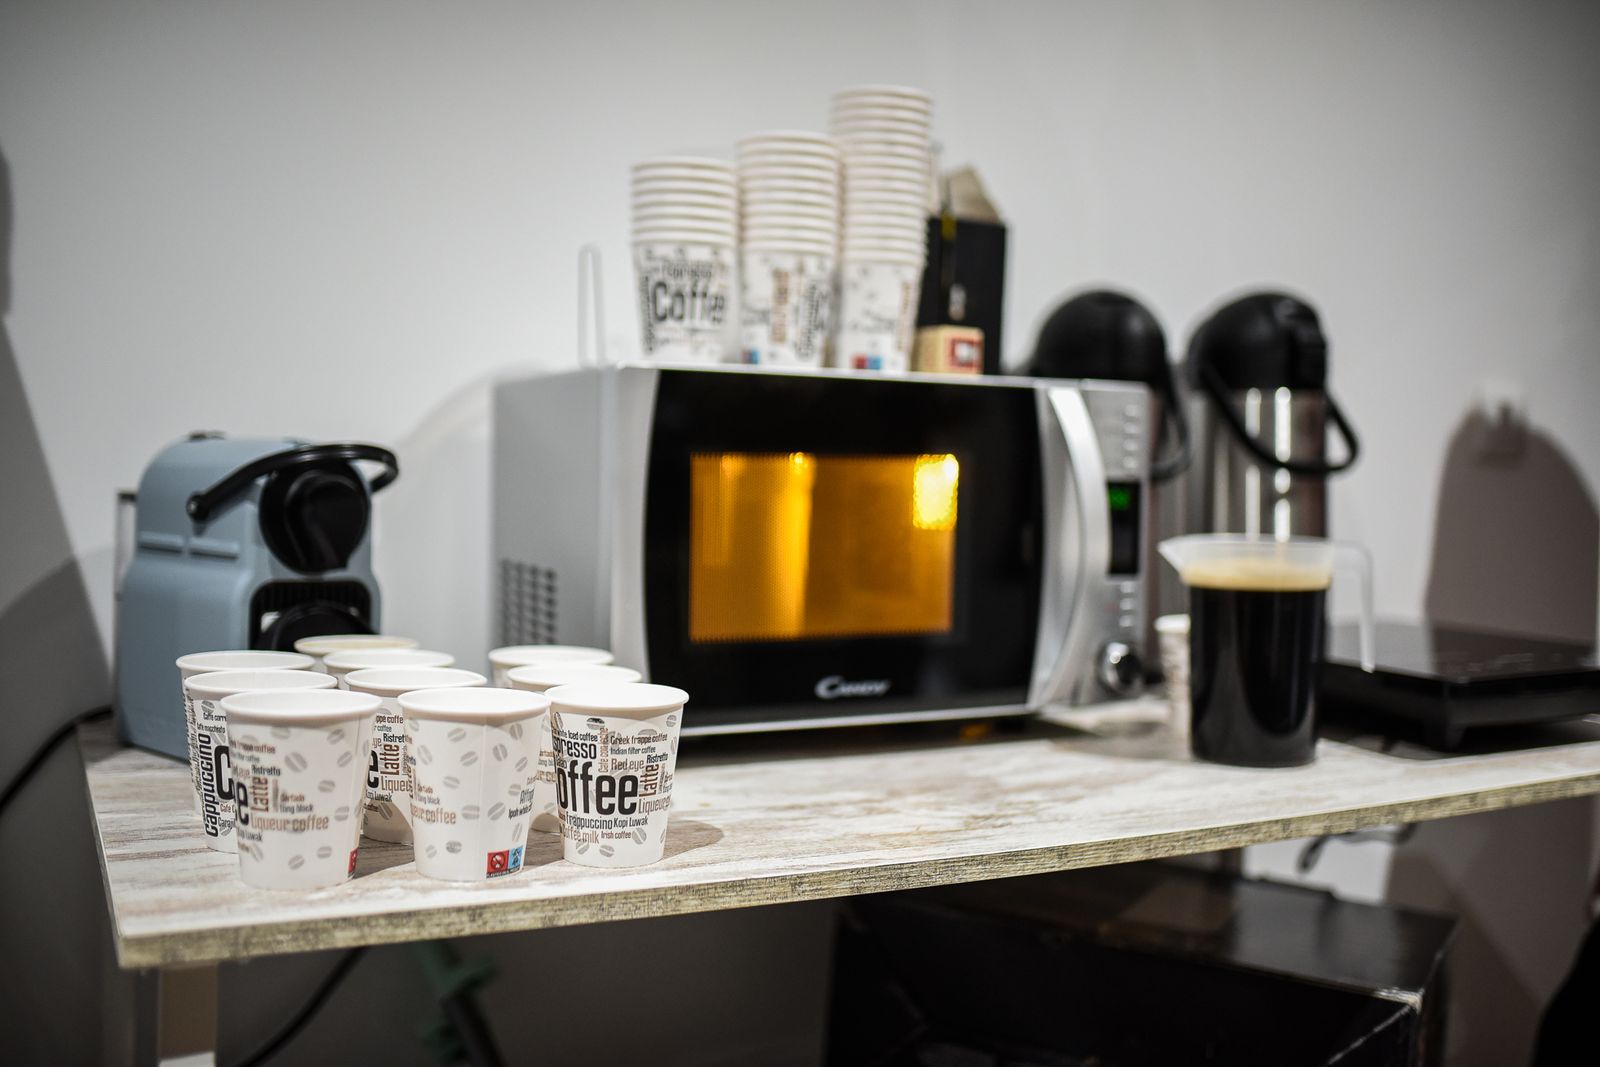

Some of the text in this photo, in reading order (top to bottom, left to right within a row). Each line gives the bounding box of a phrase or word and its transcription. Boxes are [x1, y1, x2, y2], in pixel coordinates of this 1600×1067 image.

[387, 715, 404, 723] coffe
[383, 733, 404, 743] Ristret
[580, 732, 598, 742] coffee
[610, 734, 630, 745] Greek
[631, 734, 651, 745] frappe
[610, 747, 628, 755] Indian
[641, 745, 656, 753] coffee
[379, 743, 400, 775] Latte
[611, 758, 645, 772] Red eye
[197, 733, 218, 837] Cappuccino
[557, 760, 639, 816] offee
[639, 763, 659, 797] Latte
[249, 776, 269, 812] Latte
[291, 814, 328, 832] coffee
[425, 808, 456, 824] coffee
[566, 811, 613, 830] frappuccino
[614, 816, 629, 829] Kopi
[629, 816, 648, 827] Luwak
[601, 830, 632, 839] Irish coffee
